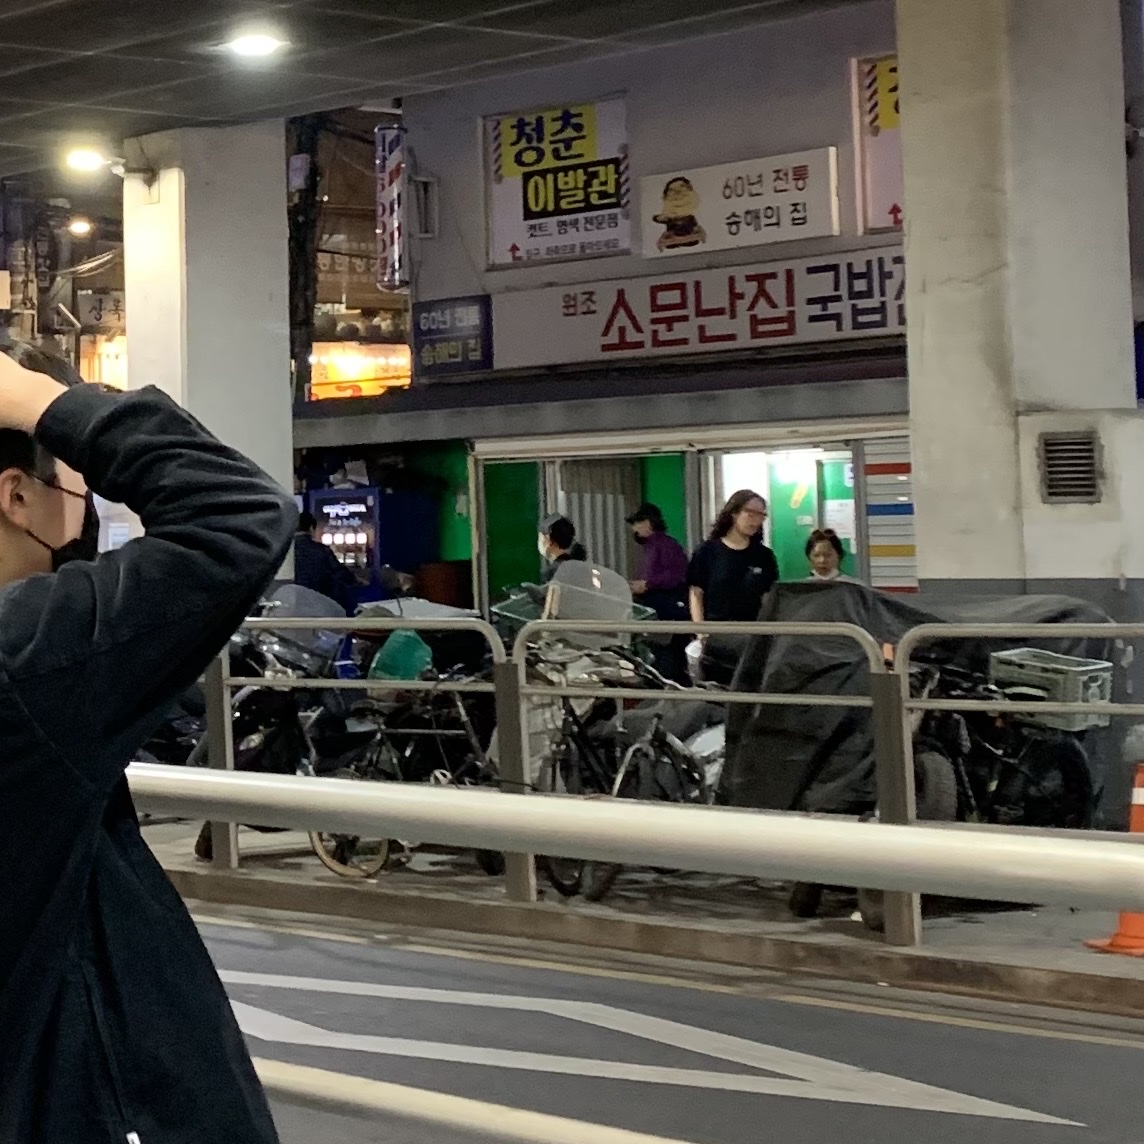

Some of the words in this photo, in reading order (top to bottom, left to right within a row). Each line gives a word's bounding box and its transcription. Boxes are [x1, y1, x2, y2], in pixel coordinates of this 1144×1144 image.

[509, 108, 587, 168] 청춘
[526, 163, 619, 212] 이발관
[722, 173, 764, 200] 60년
[771, 164, 809, 194] 전통
[724, 205, 781, 236] 송해의
[789, 202, 809, 226] 집
[419, 308, 450, 331] 60년
[562, 290, 598, 318] 원조
[600, 267, 797, 353] 소문난집
[468, 338, 482, 360] 집
